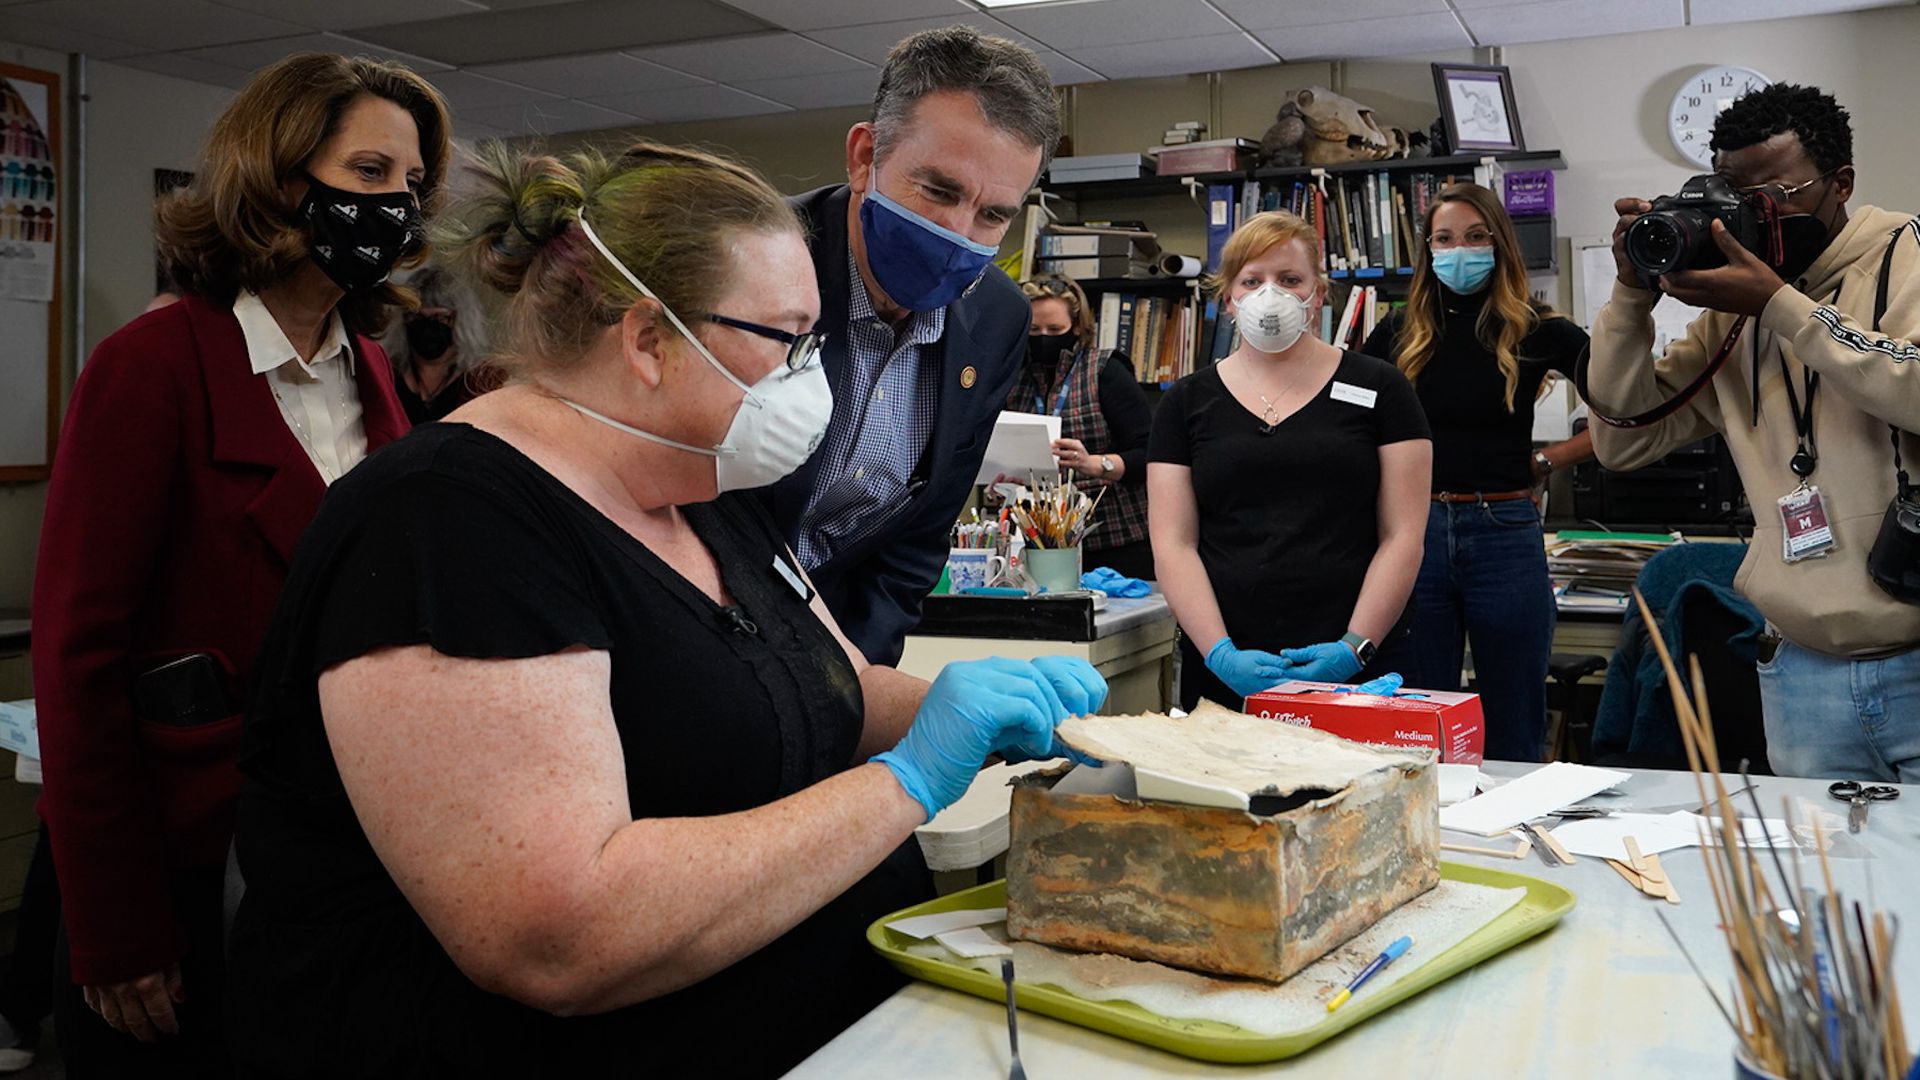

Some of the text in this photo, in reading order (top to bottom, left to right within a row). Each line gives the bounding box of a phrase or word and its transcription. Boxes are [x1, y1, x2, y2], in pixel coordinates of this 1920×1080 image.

[1721, 76, 1733, 87] 12
[1702, 83, 1712, 93] 11
[1689, 97, 1701, 107] 10
[1680, 114, 1689, 125] 9
[1685, 131, 1693, 141] 8
[1699, 143, 1708, 158] 7
[1681, 191, 1704, 199] Canon
[1799, 516, 1812, 529] M
[1394, 731, 1433, 741] Medium
